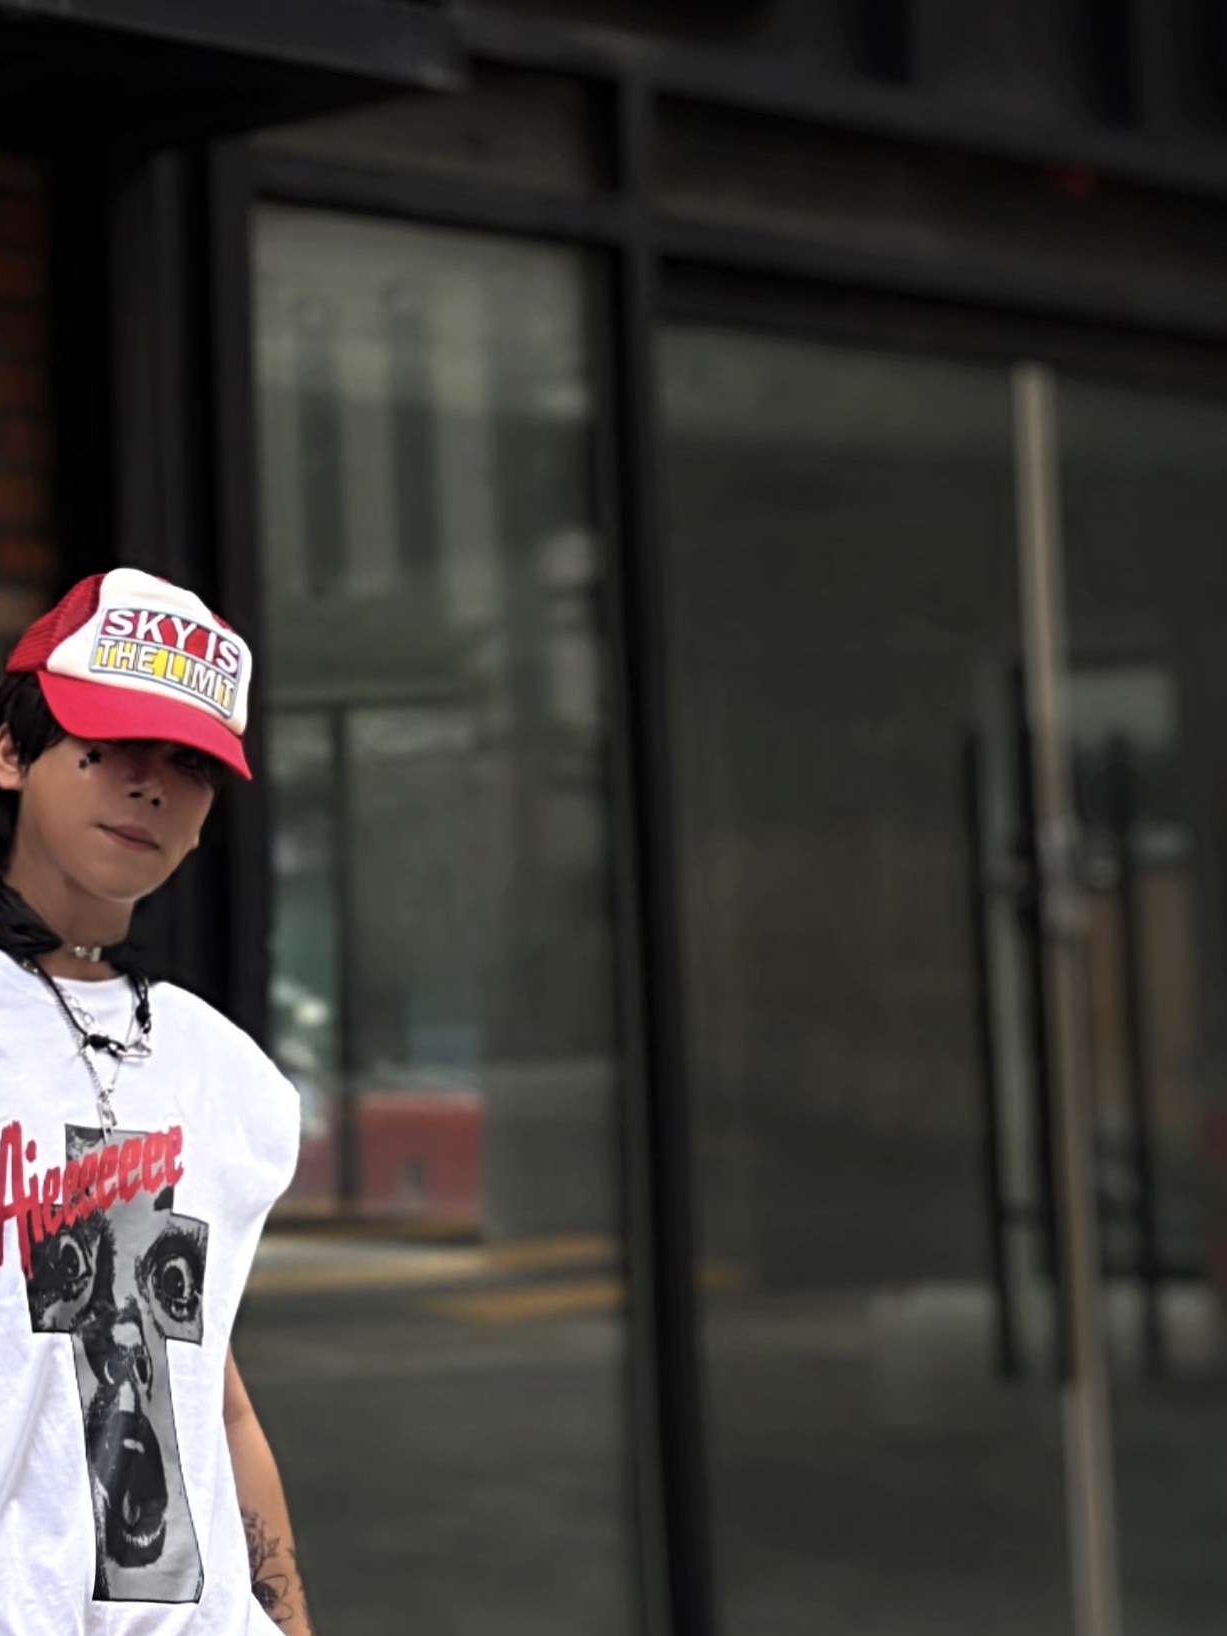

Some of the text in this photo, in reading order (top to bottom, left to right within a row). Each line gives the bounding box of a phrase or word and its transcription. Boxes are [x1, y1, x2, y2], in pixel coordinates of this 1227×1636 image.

[98, 639, 235, 708] THE LIMIT
[105, 609, 239, 674] SKY IS
